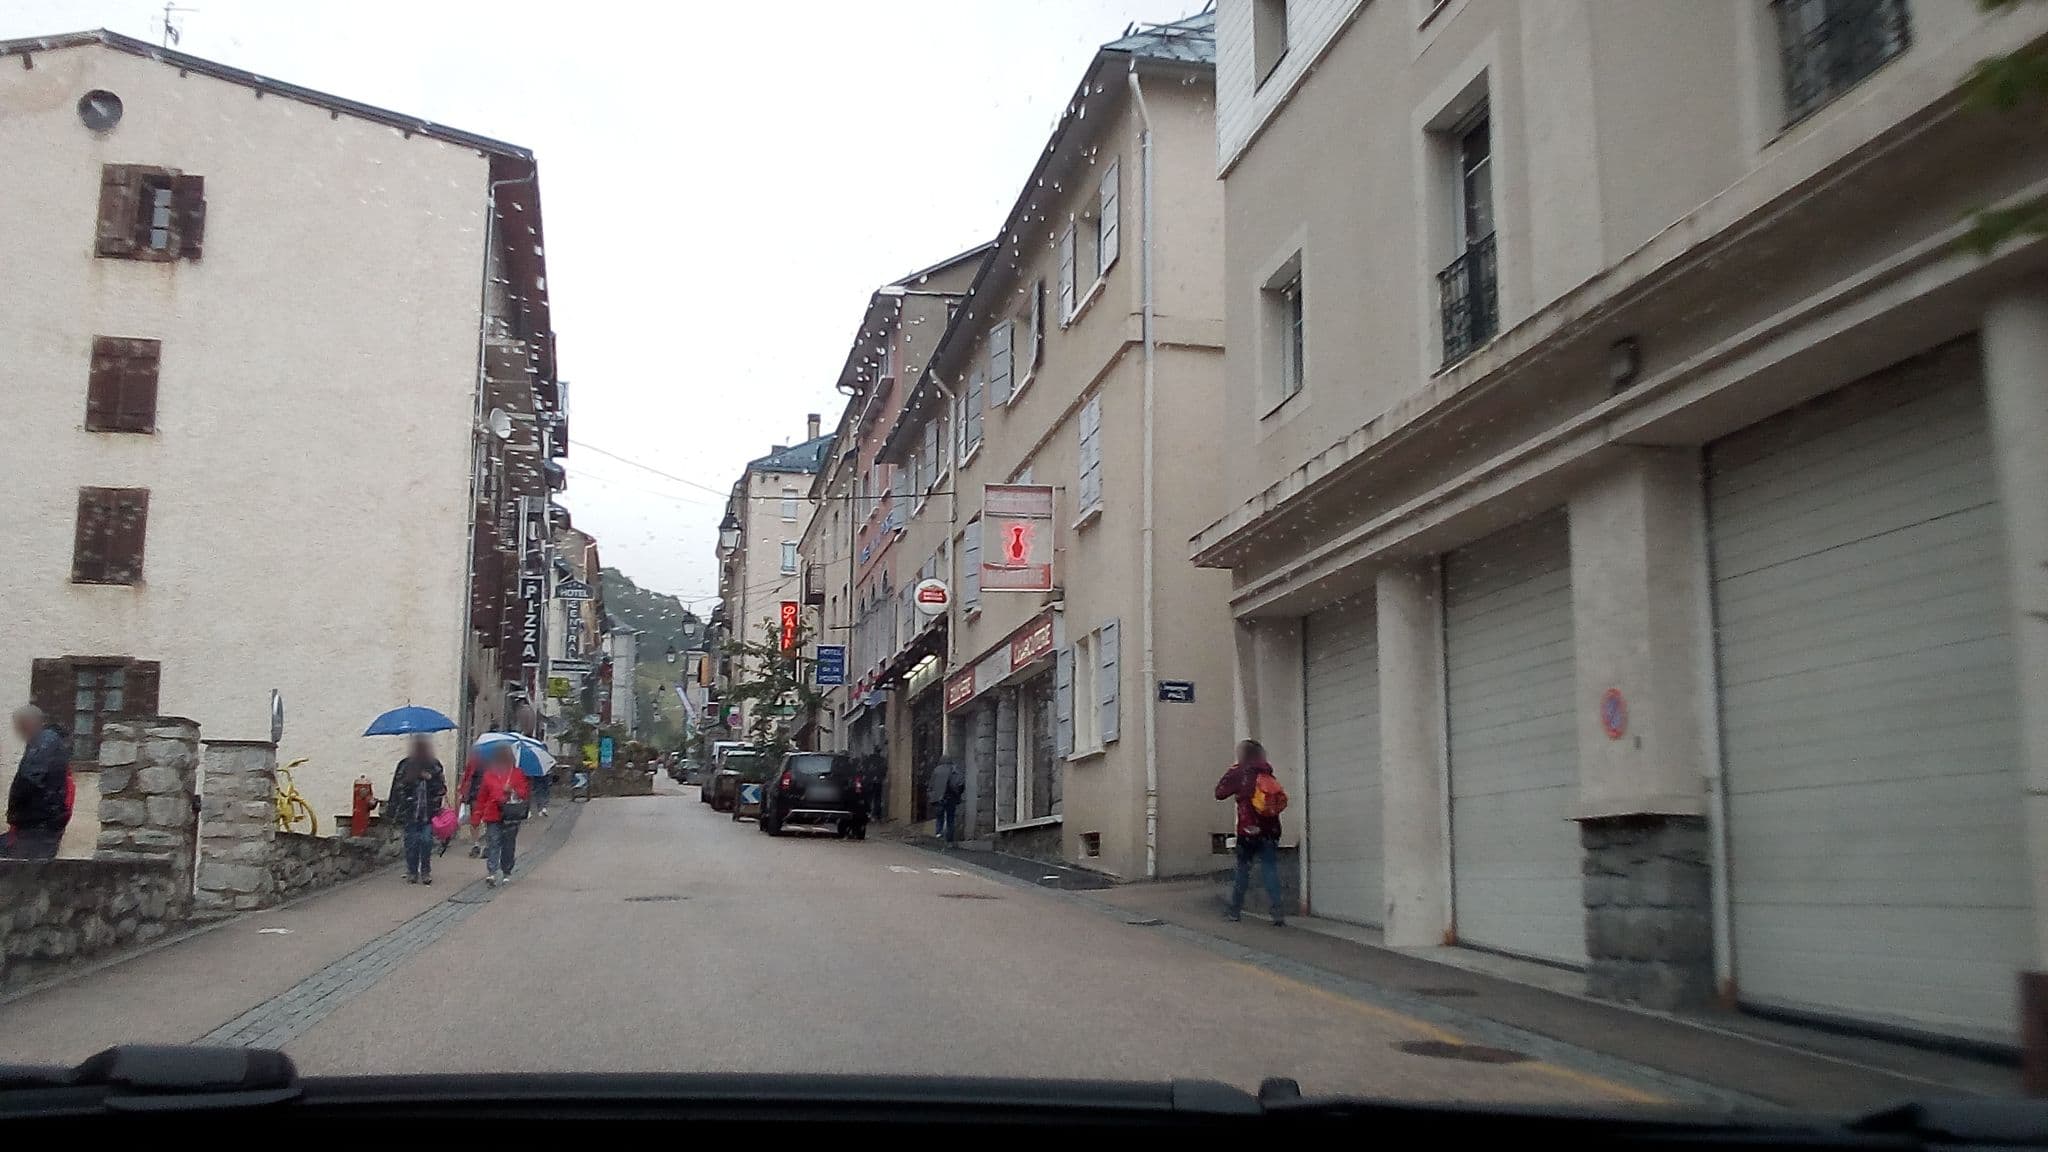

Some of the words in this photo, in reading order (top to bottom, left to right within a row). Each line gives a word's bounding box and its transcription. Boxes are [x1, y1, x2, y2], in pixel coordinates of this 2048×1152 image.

[523, 586, 537, 656] PIZZA
[560, 590, 588, 598] HOTEL
[568, 600, 579, 659] CENTRAL
